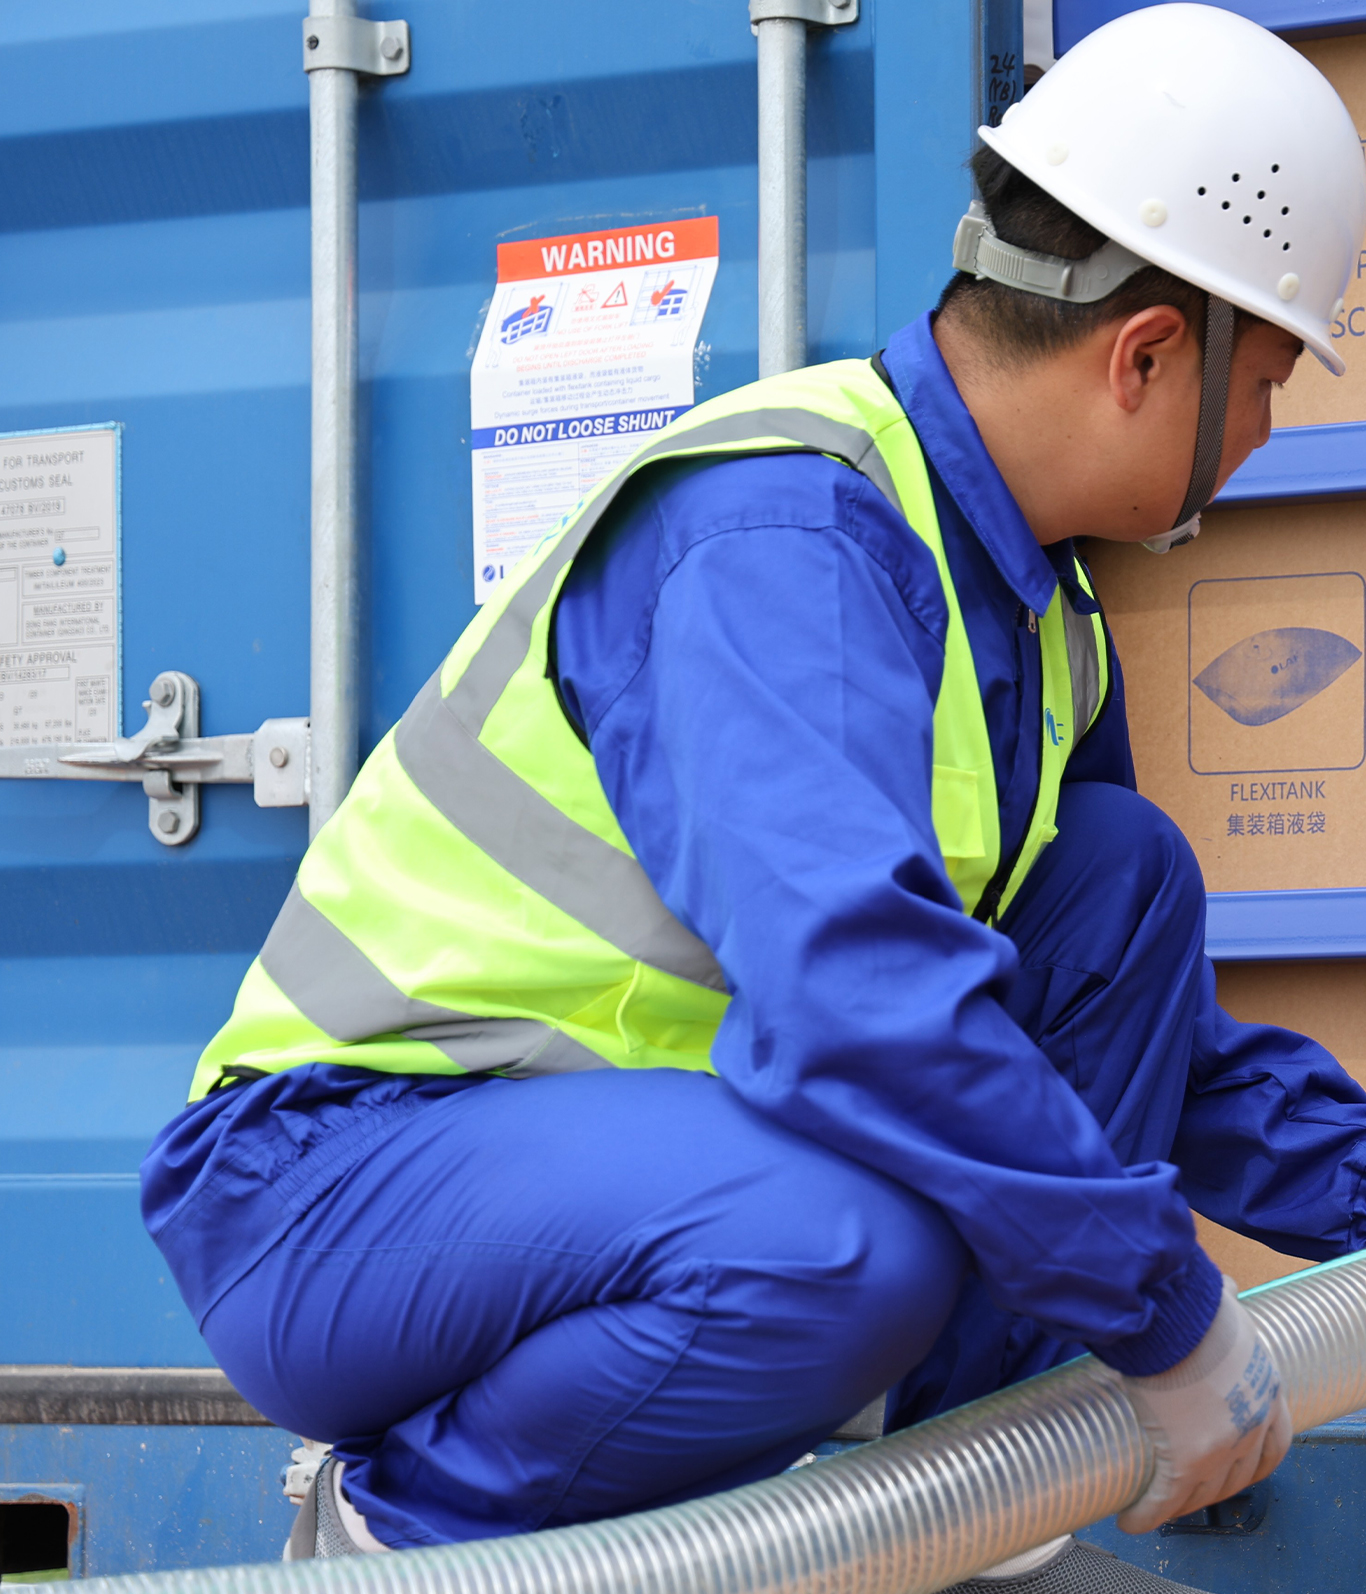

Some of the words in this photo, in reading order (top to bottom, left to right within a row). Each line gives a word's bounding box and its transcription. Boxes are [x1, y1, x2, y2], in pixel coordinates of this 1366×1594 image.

[990, 52, 1015, 77] 24
[541, 230, 676, 272] WARNING
[516, 364, 541, 373] BEGINS
[563, 356, 602, 368] DISCHARGE
[604, 351, 646, 362] COMPLETED
[560, 350, 577, 358] LEFT
[502, 389, 531, 398] Container
[532, 386, 552, 395] loaded
[594, 379, 624, 390] containing
[626, 376, 642, 386] liquid
[643, 375, 661, 384] cargo
[494, 410, 520, 420] Dynamic
[522, 408, 538, 416] surge
[540, 405, 558, 414] forces
[560, 403, 579, 412] during
[638, 393, 670, 402] movement
[494, 428, 519, 446] DO
[521, 423, 556, 443] NOT
[558, 416, 615, 439] LOOSE
[618, 410, 675, 432] SHUNT
[4, 456, 22, 470] FOR
[27, 450, 84, 466] TRANSPORT
[0, 476, 44, 492] CUSTOMS
[48, 474, 73, 488] SEAL
[27, 650, 77, 664] APPROVAL
[1230, 781, 1326, 802] FLEXITANK
[1226, 812, 1326, 837] 集装箱液袋
